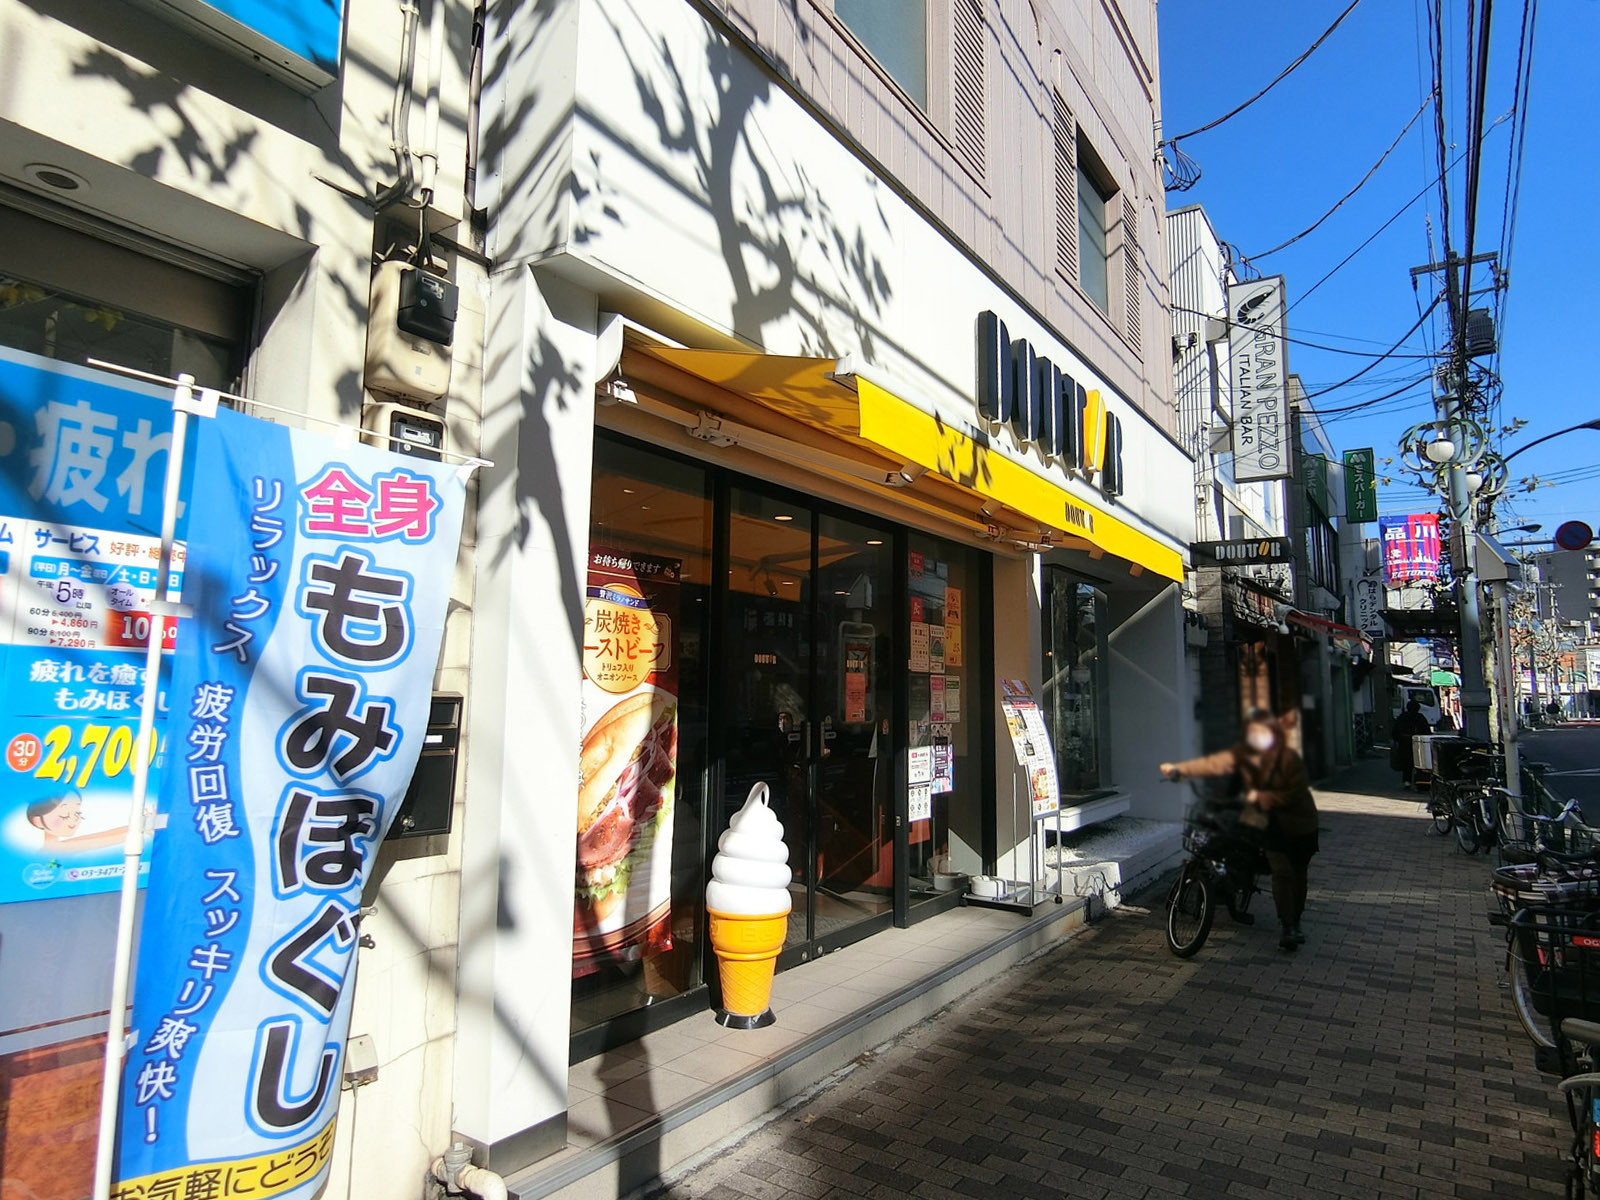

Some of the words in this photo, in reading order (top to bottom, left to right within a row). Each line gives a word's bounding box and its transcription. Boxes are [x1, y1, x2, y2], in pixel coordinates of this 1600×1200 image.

[1254, 325, 1277, 391] GRAN
[1239, 354, 1253, 410] ITALIAN
[1240, 416, 1253, 447] BAR
[1257, 397, 1280, 471] PEZZO
[303, 468, 438, 540] 全身
[1354, 465, 1366, 518] モスバーガー
[35, 528, 100, 556] サービス
[1385, 526, 1436, 541] 品川
[593, 553, 662, 575] お持ち帰りできます
[1215, 541, 1281, 560] DOUTOR
[213, 477, 284, 663] リラックス
[110, 597, 133, 607] タイム
[111, 587, 134, 597] オール
[594, 609, 641, 636] 炭焼き
[1360, 598, 1369, 630] クリニック
[596, 673, 639, 682] オニオンソース
[601, 662, 634, 672] トリュフ入り
[13, 740, 36, 757] 30
[188, 682, 240, 844] 疲労回復
[255, 555, 405, 1129] もみほぐし
